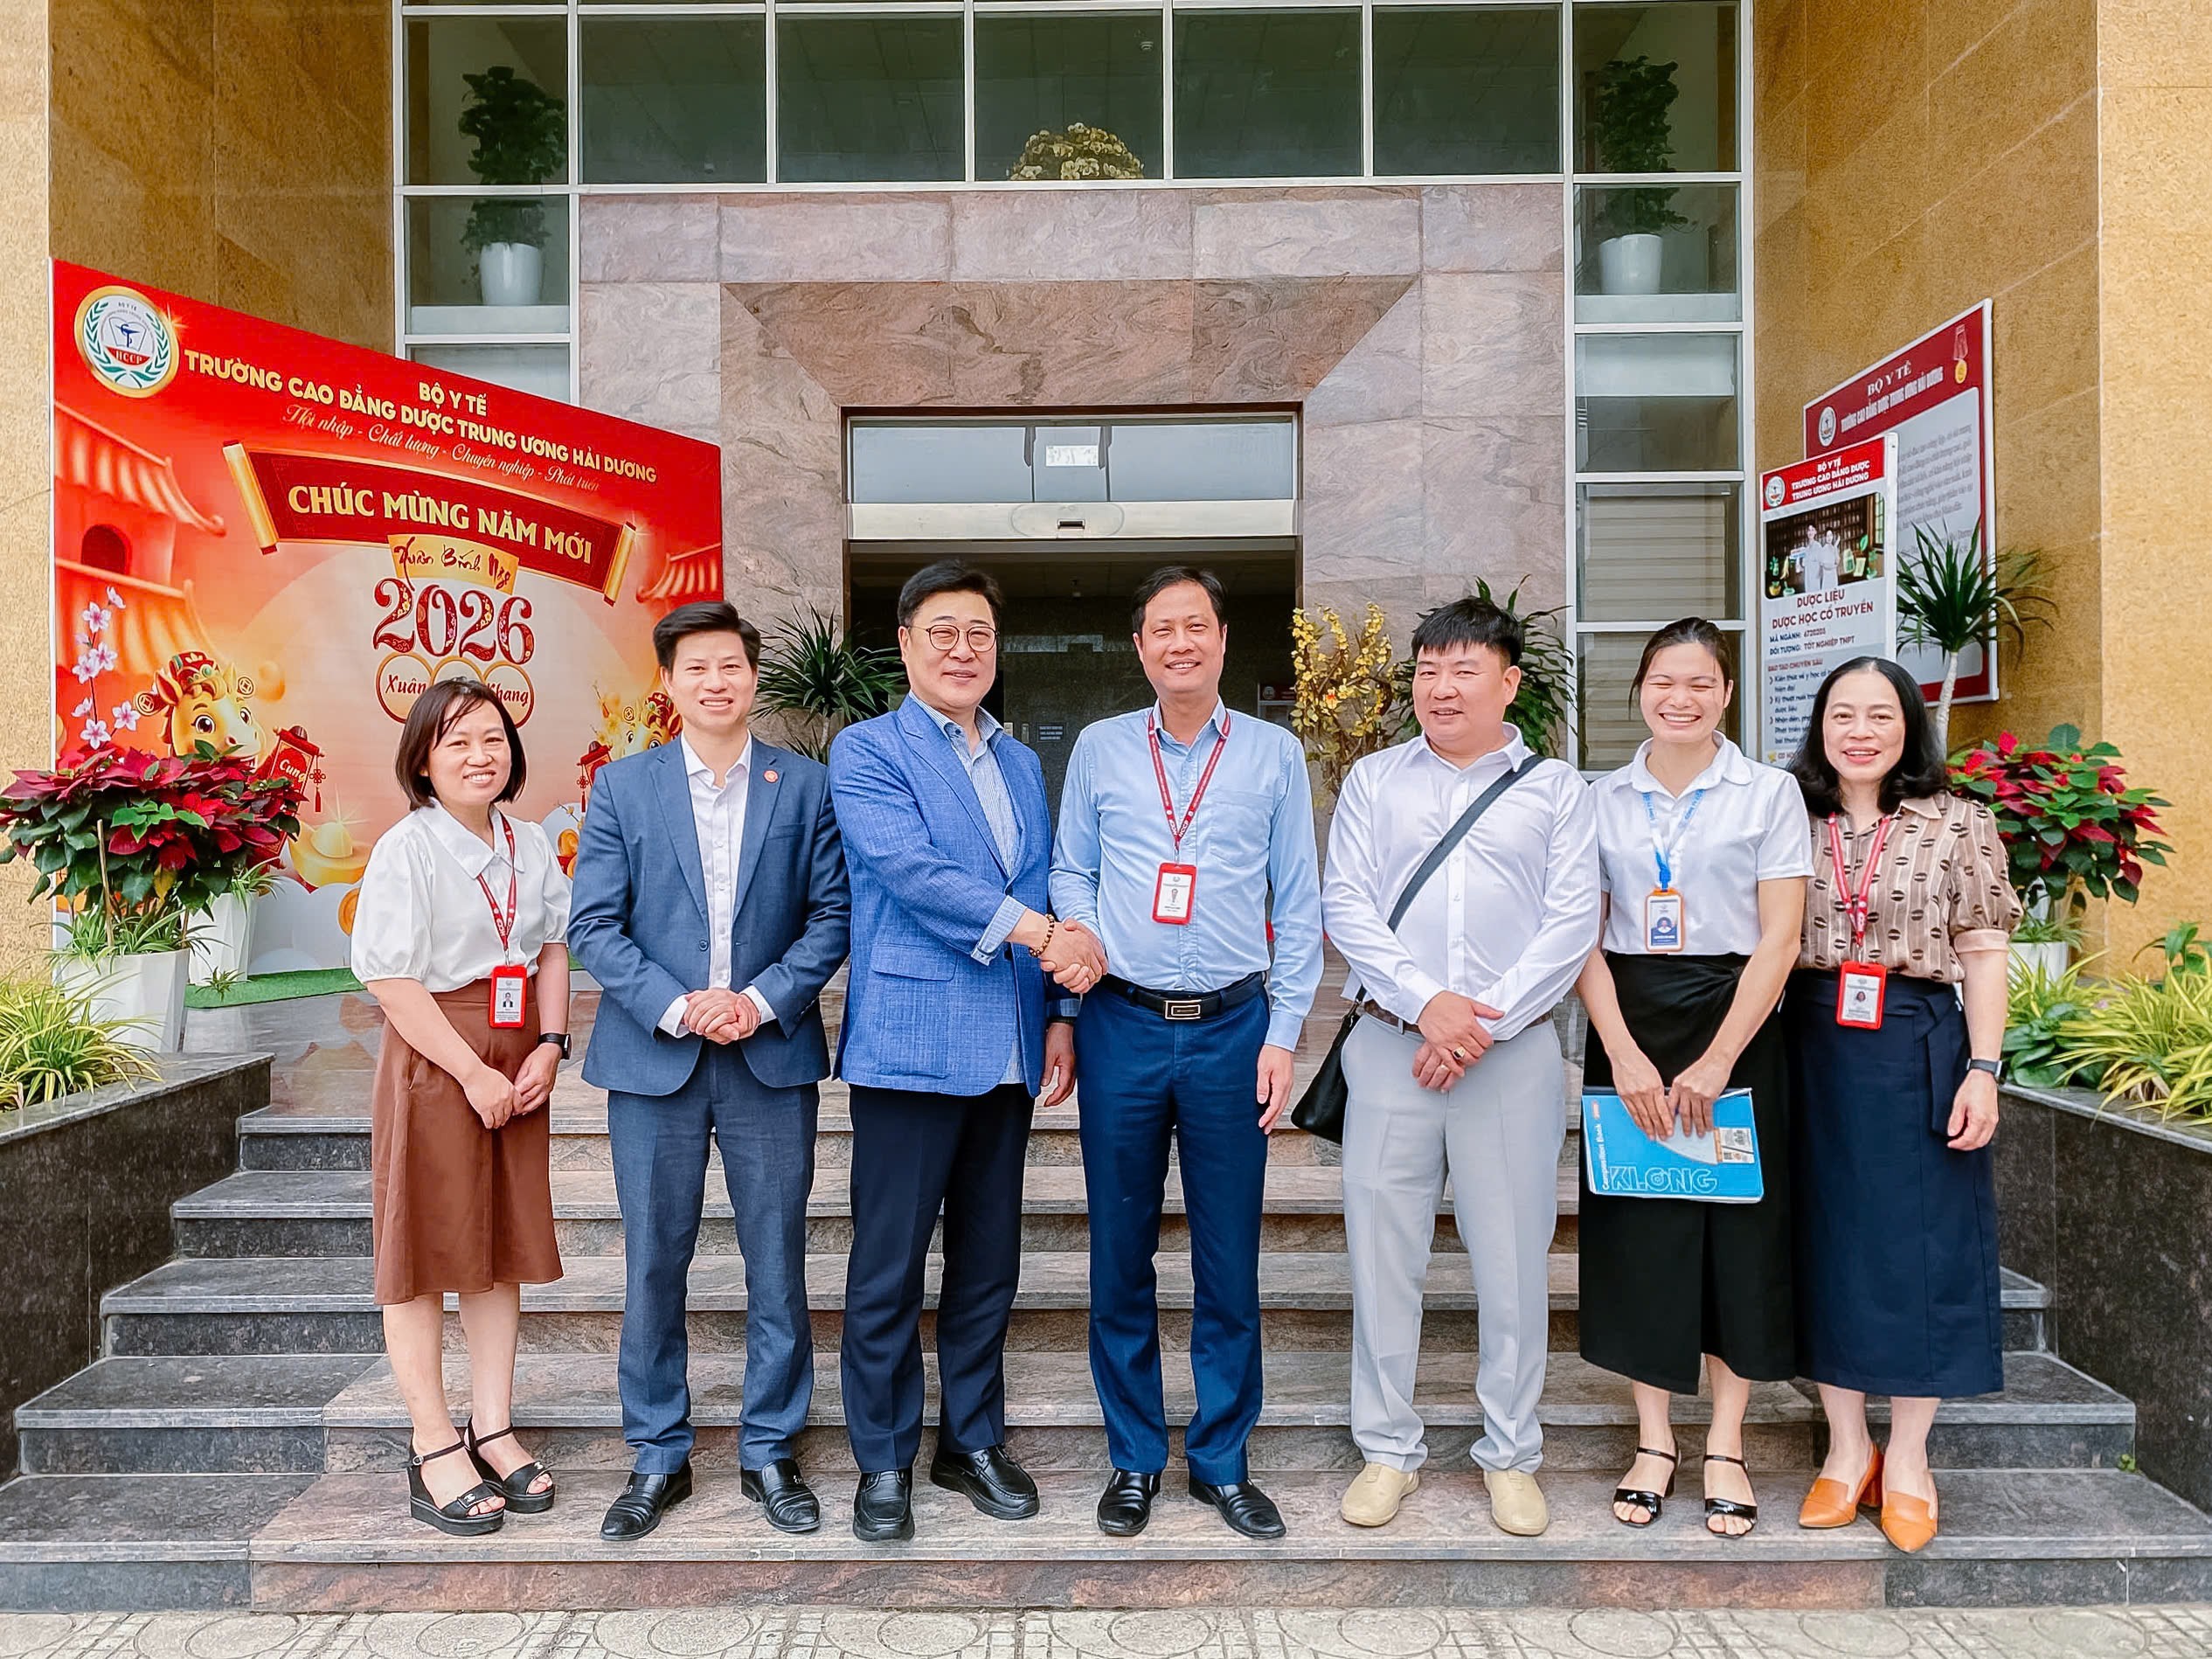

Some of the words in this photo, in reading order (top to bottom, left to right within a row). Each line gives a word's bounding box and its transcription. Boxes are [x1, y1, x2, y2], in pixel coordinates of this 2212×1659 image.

[1884, 371, 1894, 385] Y
[419, 381, 445, 409] BỘ
[448, 390, 462, 409] Y
[465, 392, 488, 417] TẾ
[184, 349, 283, 392] TRƯỜNG
[288, 377, 334, 405] CAO
[339, 383, 397, 420] ĐẲNG
[400, 404, 454, 436] DƯỢC
[457, 419, 517, 450] TRUNG
[520, 434, 570, 462] ƯƠNG
[572, 446, 600, 470] HẢI
[603, 455, 657, 483] DƯƠNG
[318, 414, 354, 440] nhập
[368, 423, 404, 448] Chất
[404, 433, 440, 459] lượng
[452, 443, 496, 469] Chuyên
[498, 459, 535, 480] nghiệp
[1817, 473, 1830, 482] CAO
[288, 482, 375, 516] CHÚC
[383, 489, 469, 528] MỪNG
[477, 510, 537, 547] NĂM
[544, 525, 593, 565] MỚI
[1772, 616, 1797, 630] DƯỢC
[1799, 612, 1818, 626] HỌC
[1835, 599, 1874, 618] TRUYỀN
[1797, 593, 1822, 608] DƯỢC
[373, 578, 535, 665] 2026
[385, 674, 426, 694] Xuân
[1179, 820, 1189, 836] HCCP
[496, 918, 506, 936] HCCP
[1609, 1165, 1717, 1193] KLONG
